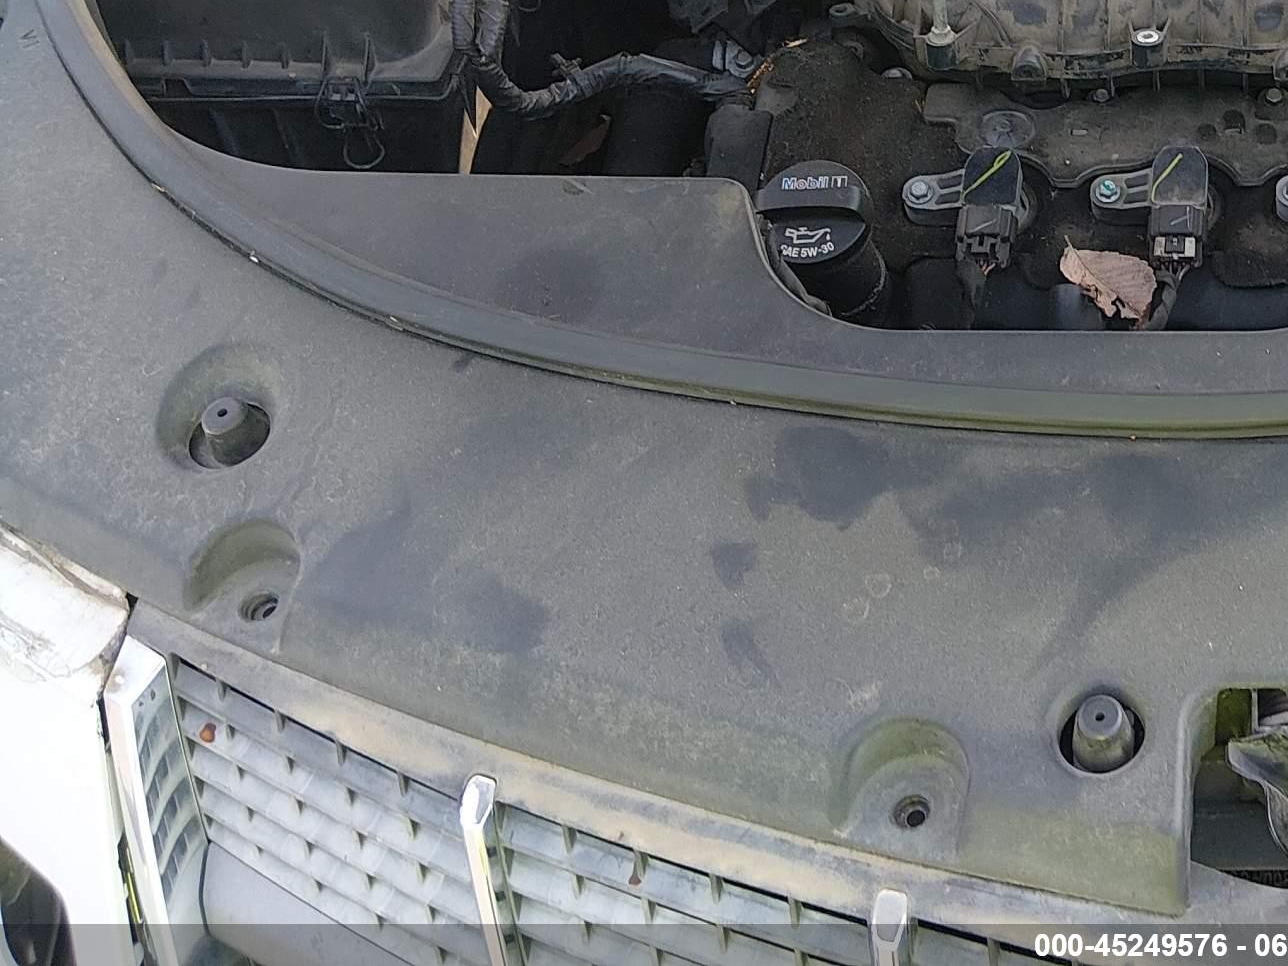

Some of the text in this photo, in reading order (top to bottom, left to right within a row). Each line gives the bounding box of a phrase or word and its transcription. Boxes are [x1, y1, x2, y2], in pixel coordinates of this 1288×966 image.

[782, 176, 829, 190] Mobil
[780, 242, 835, 258] SAE 5W-30
